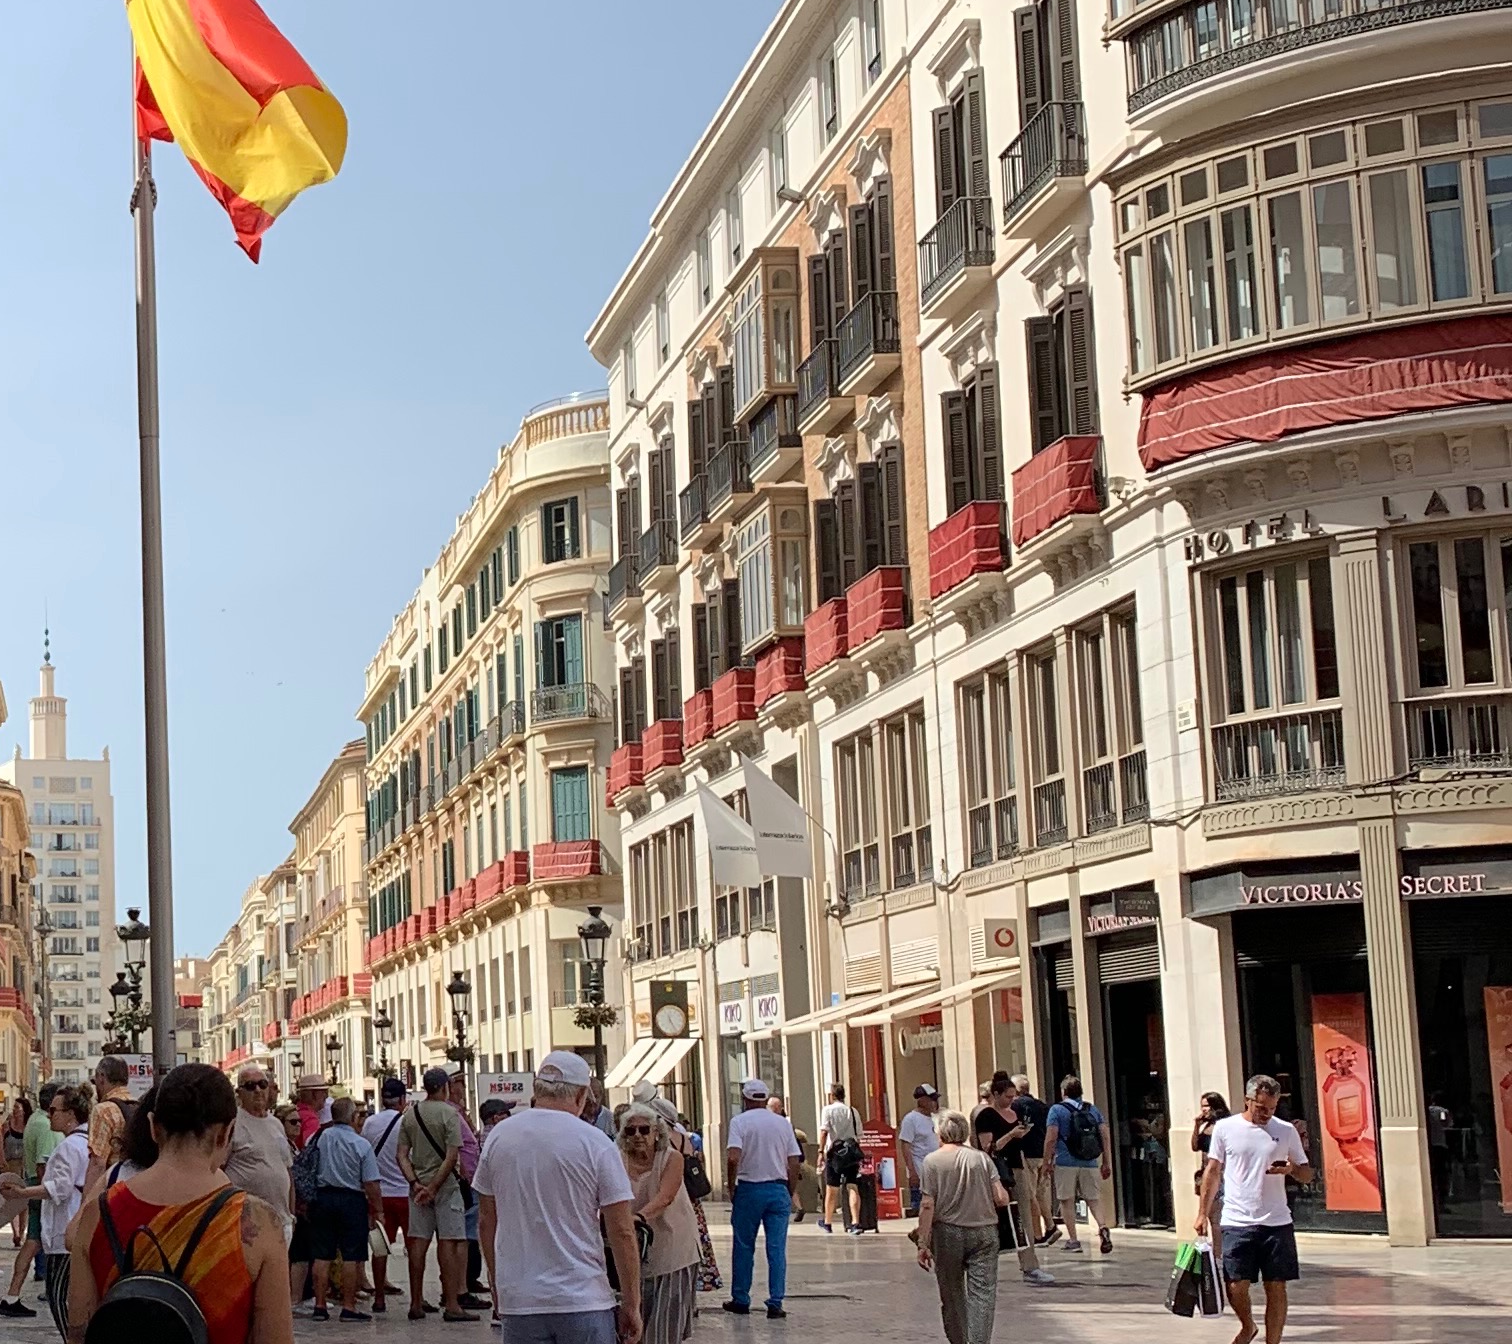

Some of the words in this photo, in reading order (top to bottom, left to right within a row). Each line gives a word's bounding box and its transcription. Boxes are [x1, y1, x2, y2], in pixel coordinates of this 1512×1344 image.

[1184, 509, 1326, 563] HOTEL
[1382, 482, 1510, 525] LARI
[1239, 880, 1363, 905] VICTORIA'S
[1400, 874, 1486, 896] SECRET
[724, 1002, 742, 1023] KIKO
[758, 996, 778, 1019] KIKO
